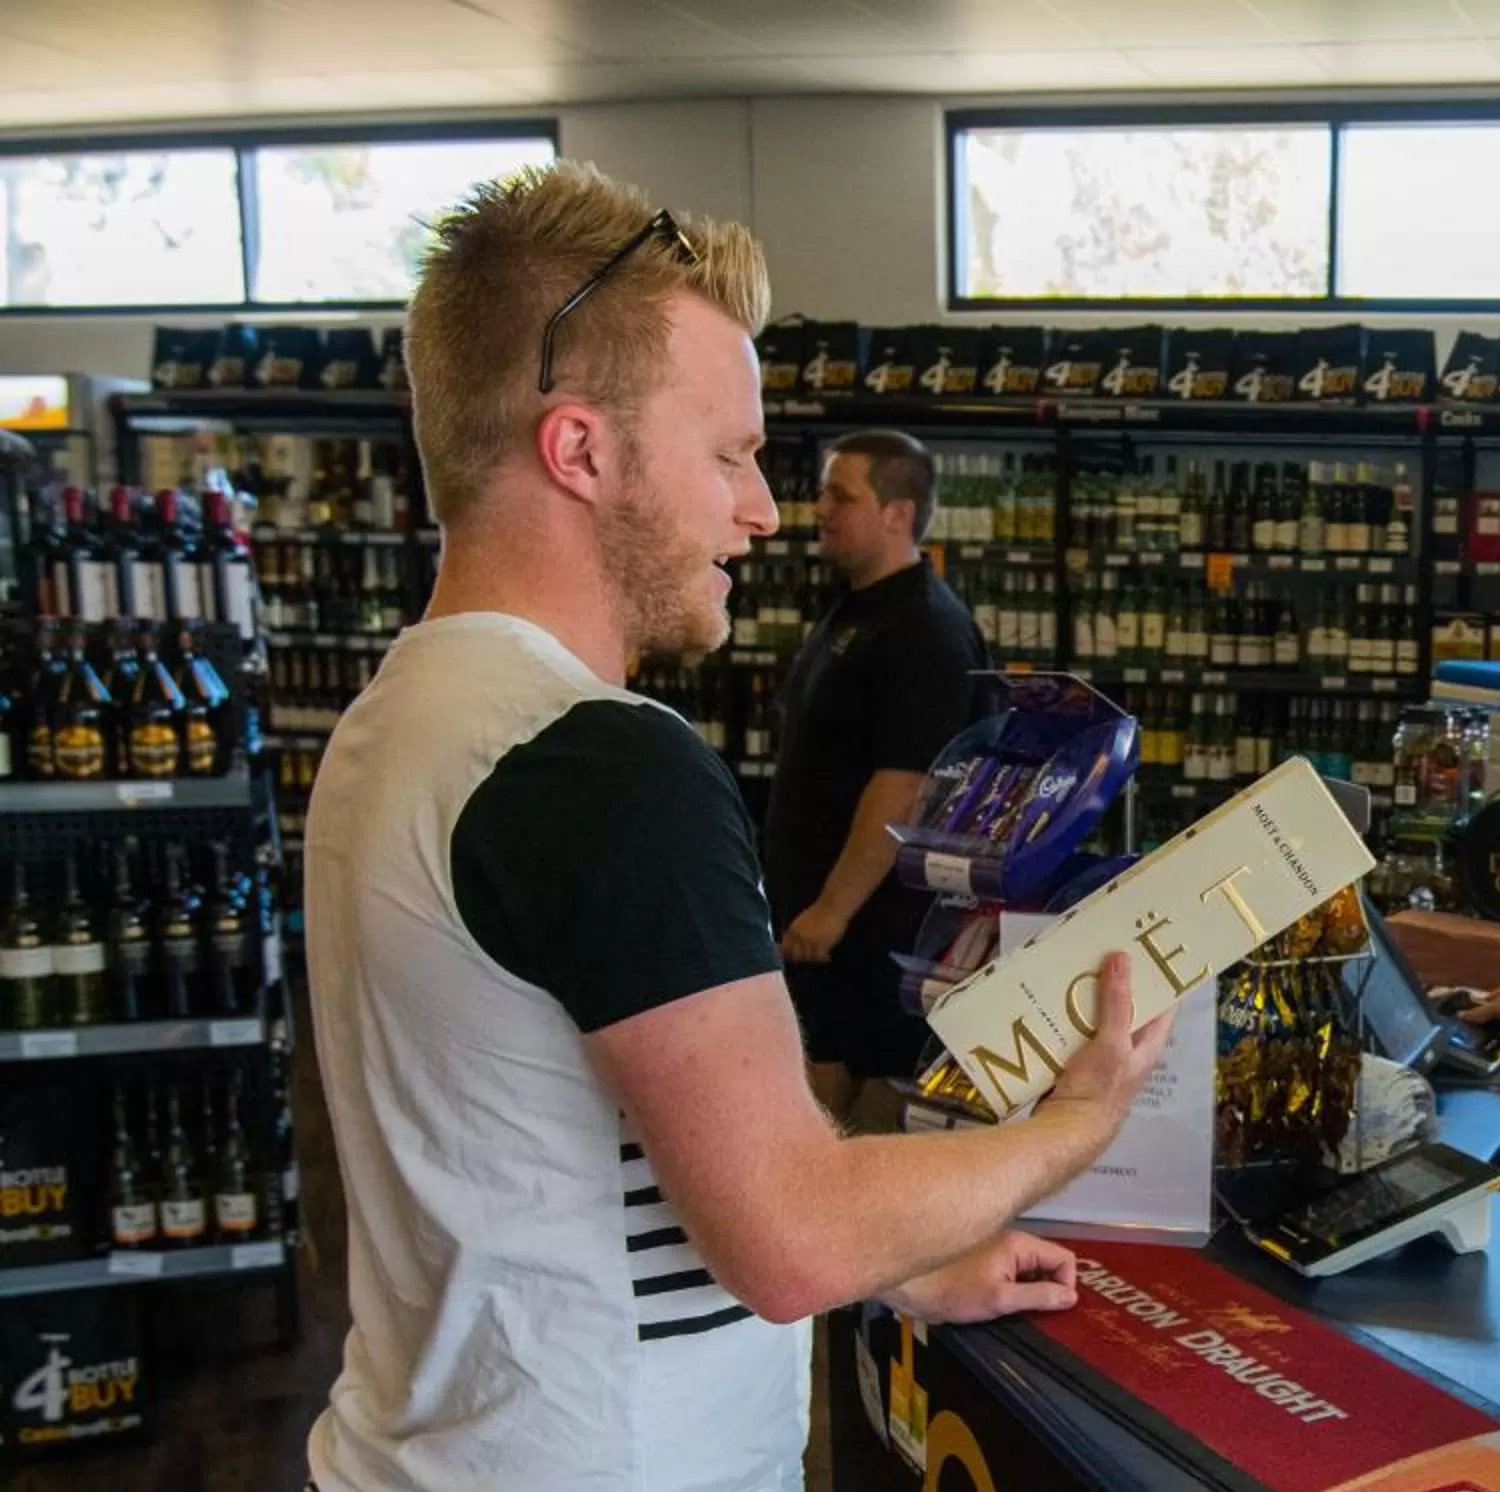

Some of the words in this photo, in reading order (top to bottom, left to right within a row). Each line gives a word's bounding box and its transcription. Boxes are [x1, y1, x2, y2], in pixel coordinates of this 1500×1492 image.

[1075, 1257, 1190, 1330] CARLTON
[1172, 1328, 1351, 1423] DRAUGHT
[12, 1349, 73, 1422] 4
[71, 1373, 136, 1412] BUY
